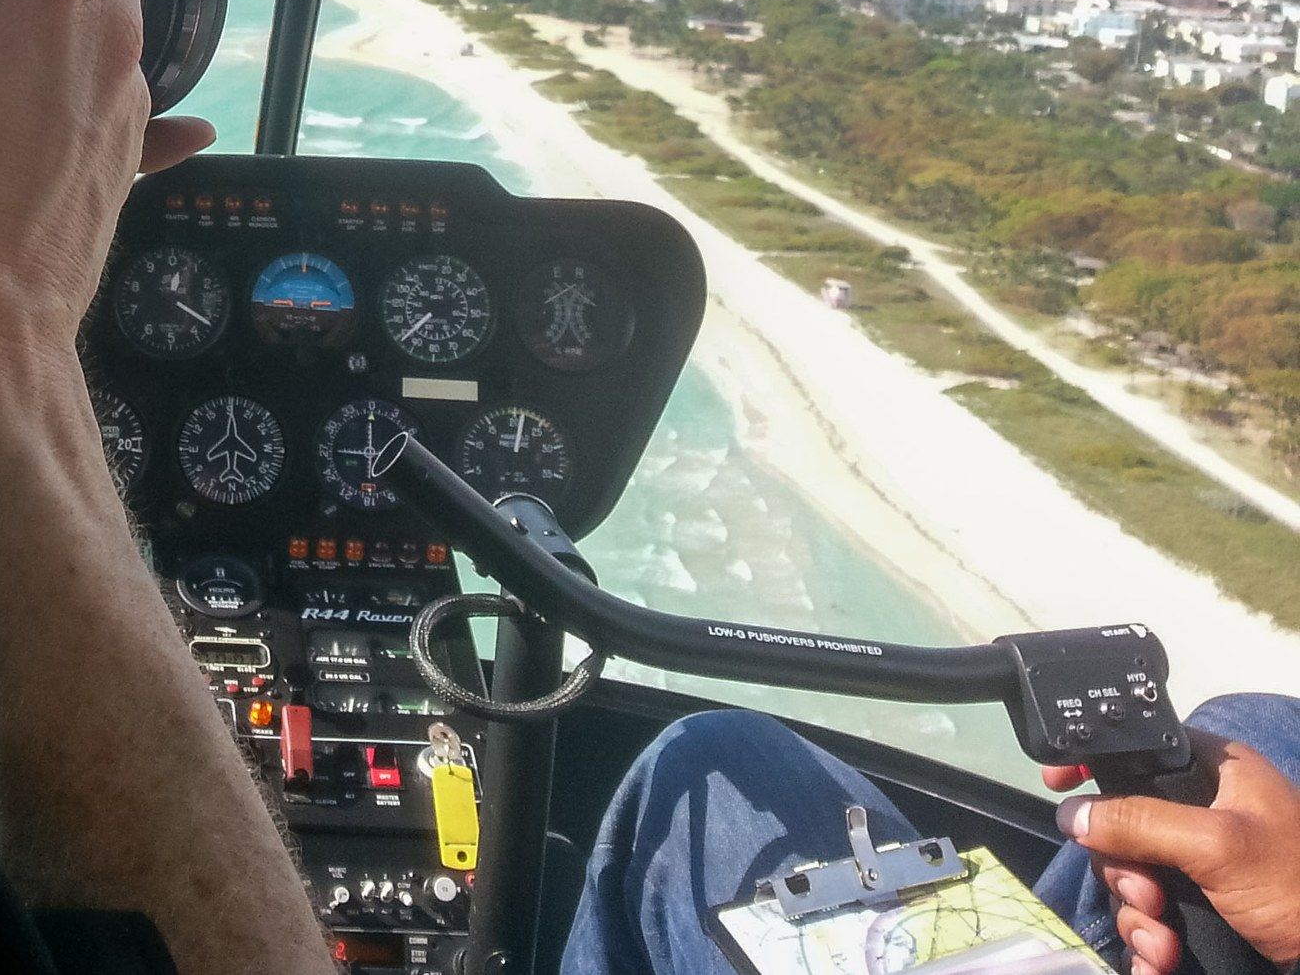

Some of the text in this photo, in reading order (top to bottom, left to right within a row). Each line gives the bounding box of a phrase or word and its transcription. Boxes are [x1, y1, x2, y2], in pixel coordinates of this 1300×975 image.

[168, 255, 177, 266] 0
[146, 262, 155, 273] 9
[131, 305, 138, 315] 7
[144, 324, 153, 335] 6
[190, 326, 199, 336] 4
[167, 332, 176, 344] 5
[368, 401, 376, 411] 0
[391, 408, 400, 418] 3
[117, 438, 132, 451] 20
[189, 444, 200, 454] E
[263, 443, 274, 454] W
[319, 443, 329, 458] 27
[228, 481, 237, 492] N
[363, 496, 375, 507] 18
[301, 607, 414, 623] R44 Raven
[708, 625, 883, 656] LOW-G PUSHOVERS PROHIBITED
[1126, 672, 1146, 683] HYD
[1087, 686, 1120, 699] CH SEL
[1056, 698, 1082, 709] FREQ
